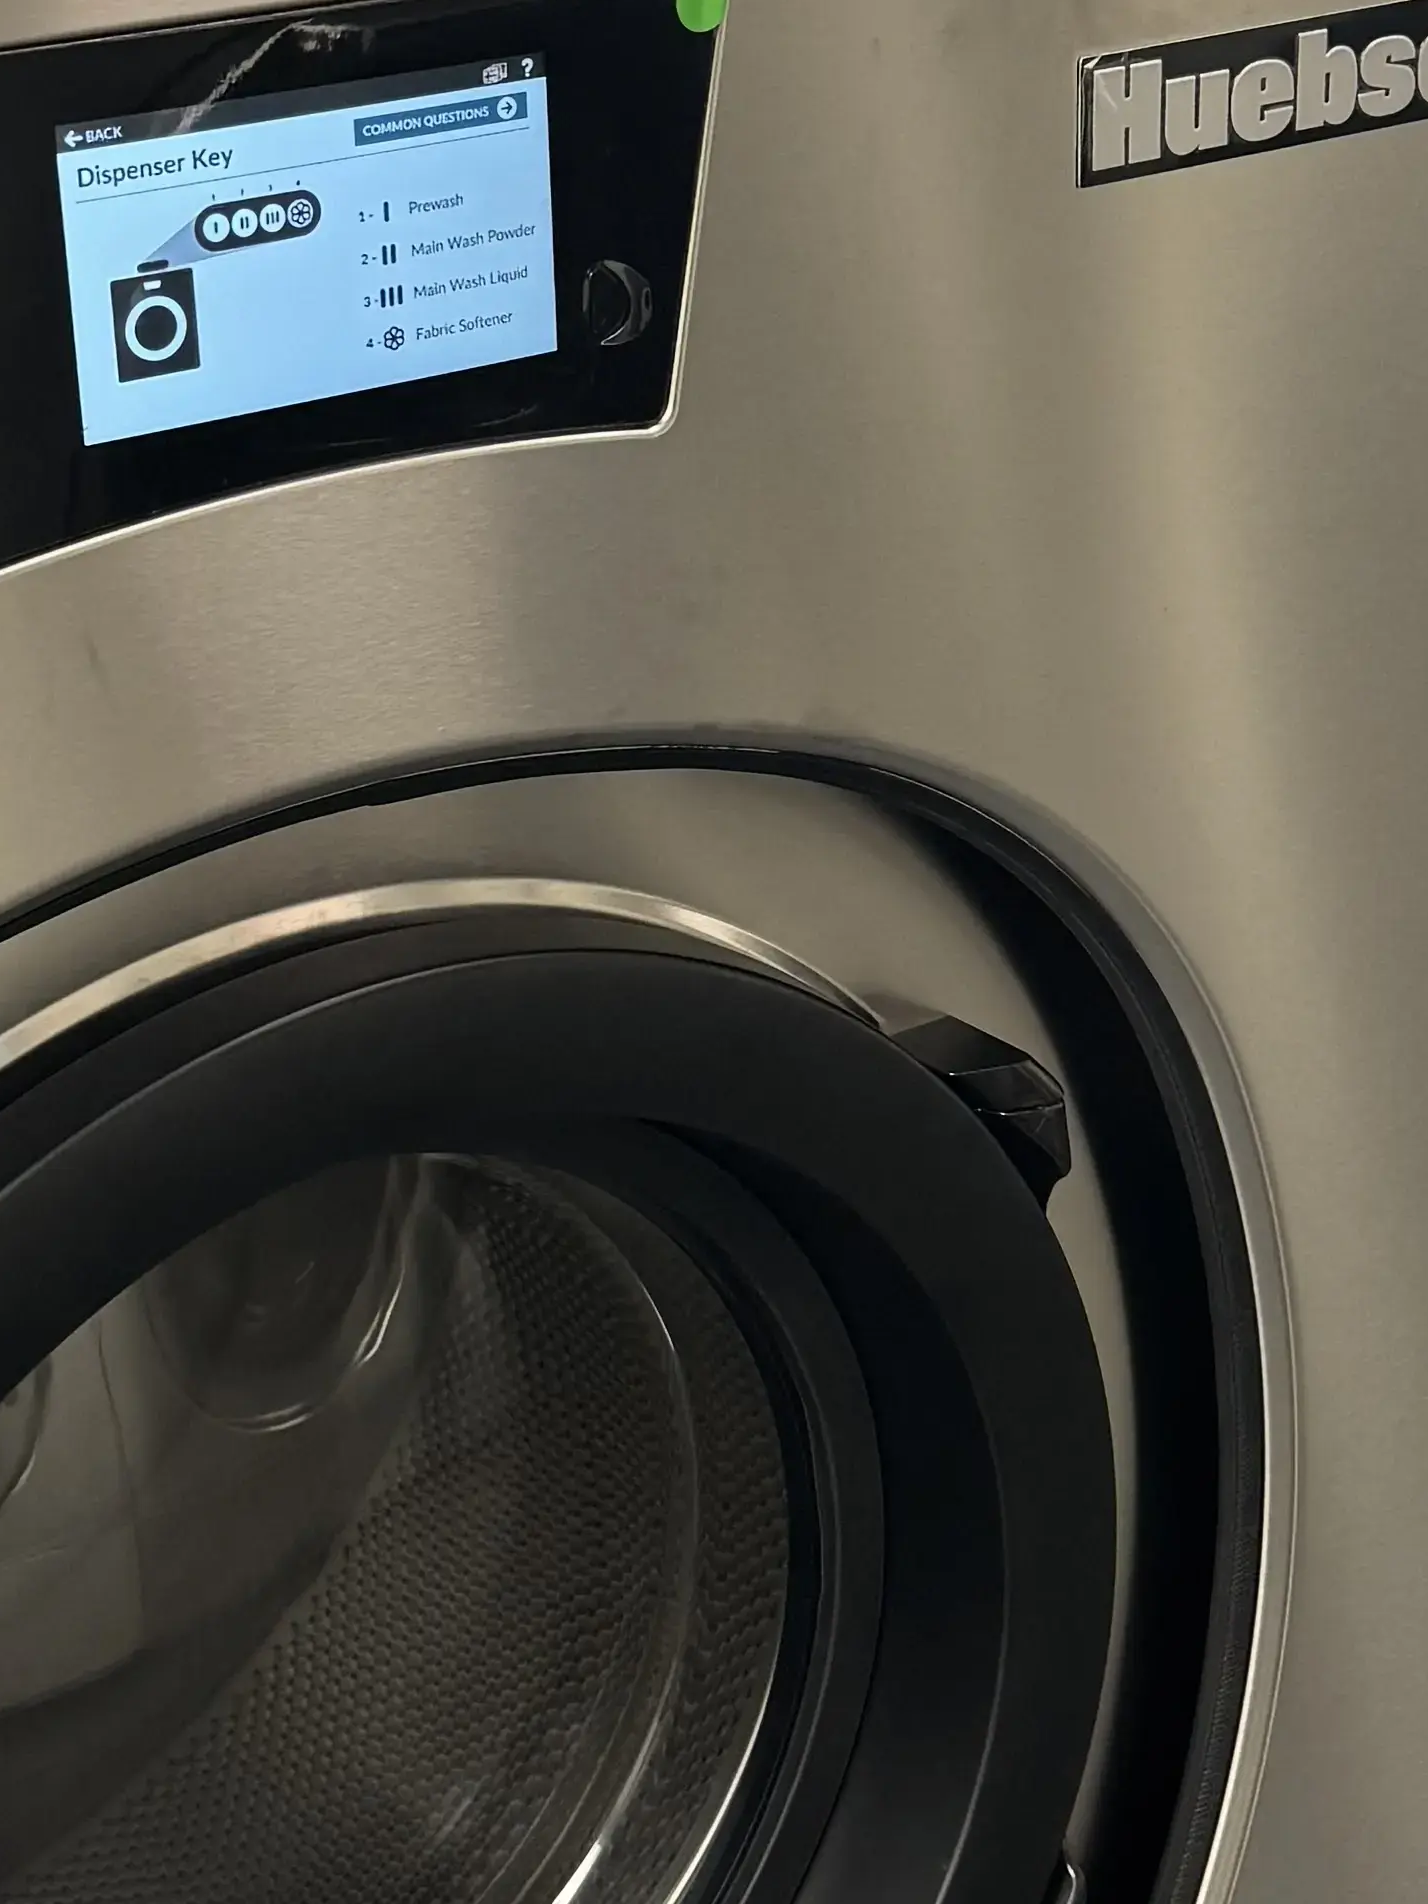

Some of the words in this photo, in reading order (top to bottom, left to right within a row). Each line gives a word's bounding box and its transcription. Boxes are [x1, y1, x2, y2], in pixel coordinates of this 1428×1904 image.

[85, 126, 122, 143] BACK
[362, 117, 422, 137] COMMON
[423, 106, 490, 128] QUESTIONS
[77, 157, 185, 188] Dispenser
[192, 148, 233, 170] Key
[408, 193, 464, 214] Prewash
[411, 240, 444, 257] Main
[447, 232, 484, 250] Wash
[488, 224, 536, 243] Powder
[414, 282, 446, 299] Main
[450, 274, 486, 292] Wash
[490, 265, 528, 284] Liquid
[416, 323, 456, 341] Fabric
[459, 312, 513, 333] Softener
